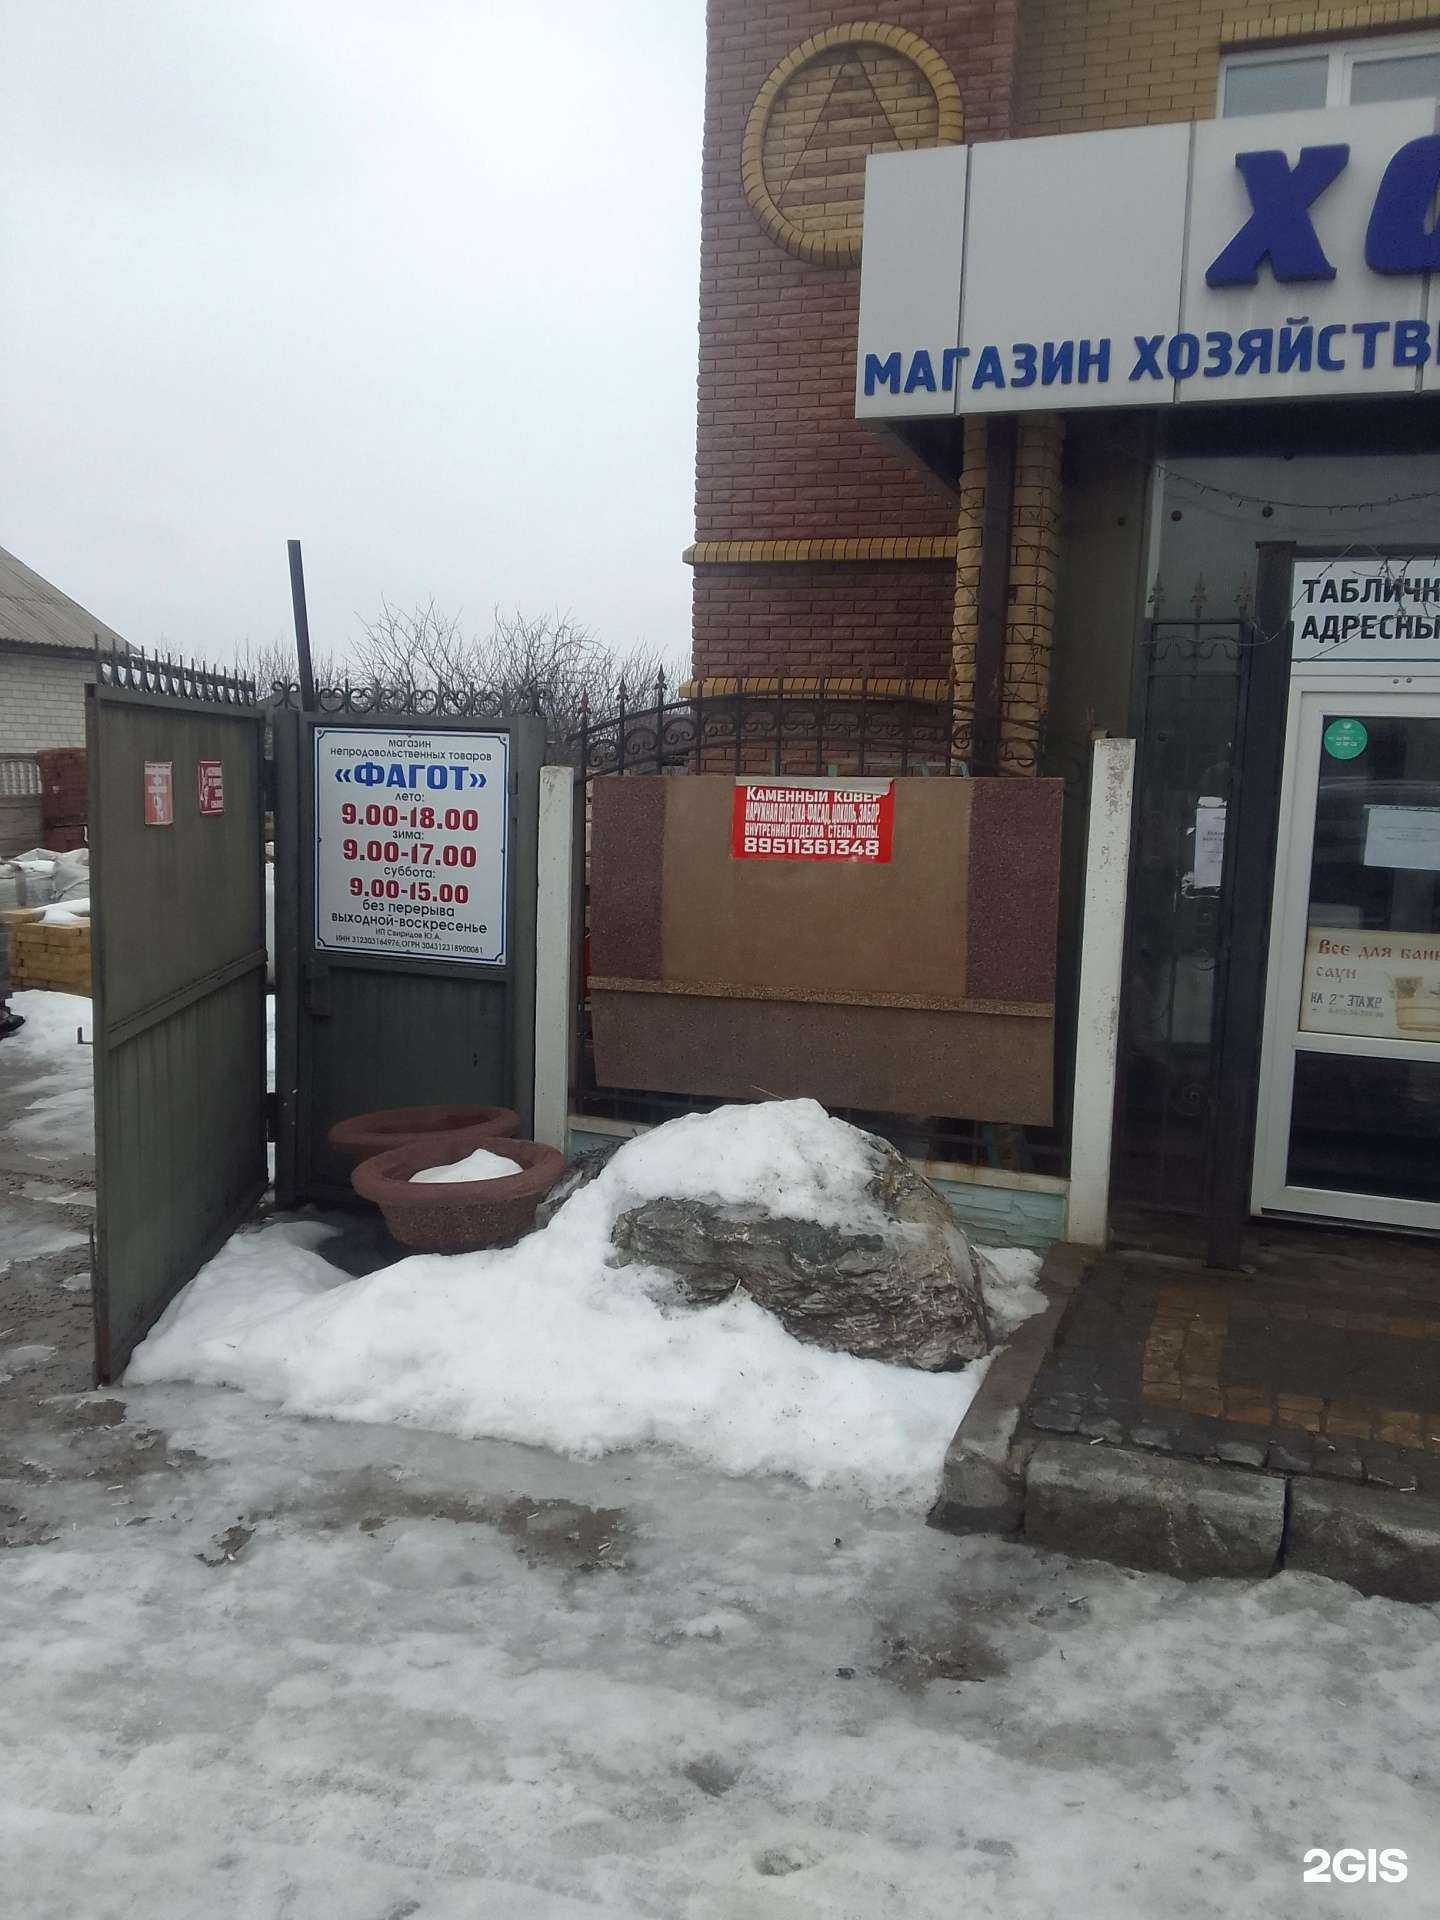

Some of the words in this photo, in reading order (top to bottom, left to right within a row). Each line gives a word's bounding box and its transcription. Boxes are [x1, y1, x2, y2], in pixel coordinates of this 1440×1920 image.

[863, 338, 1112, 396] МАГАЗИН
[1128, 316, 1440, 381] ХОЗЯЙСТВ
[388, 738, 432, 749] магазин
[330, 747, 446, 760] непродовольственных
[449, 751, 492, 763] товаров
[334, 761, 488, 791] «ФАГОТ»
[395, 792, 425, 802] лето:
[341, 803, 480, 831] 9.00-18.00
[392, 830, 424, 841] зима:
[342, 838, 477, 868] 9.00-17.00
[744, 837, 880, 856] 89511361348
[384, 866, 436, 879] суббота:
[350, 877, 469, 904] 9.00-15.00
[362, 899, 385, 912] без
[388, 902, 455, 917] перерыва
[331, 912, 488, 934] выходной-воскресенье
